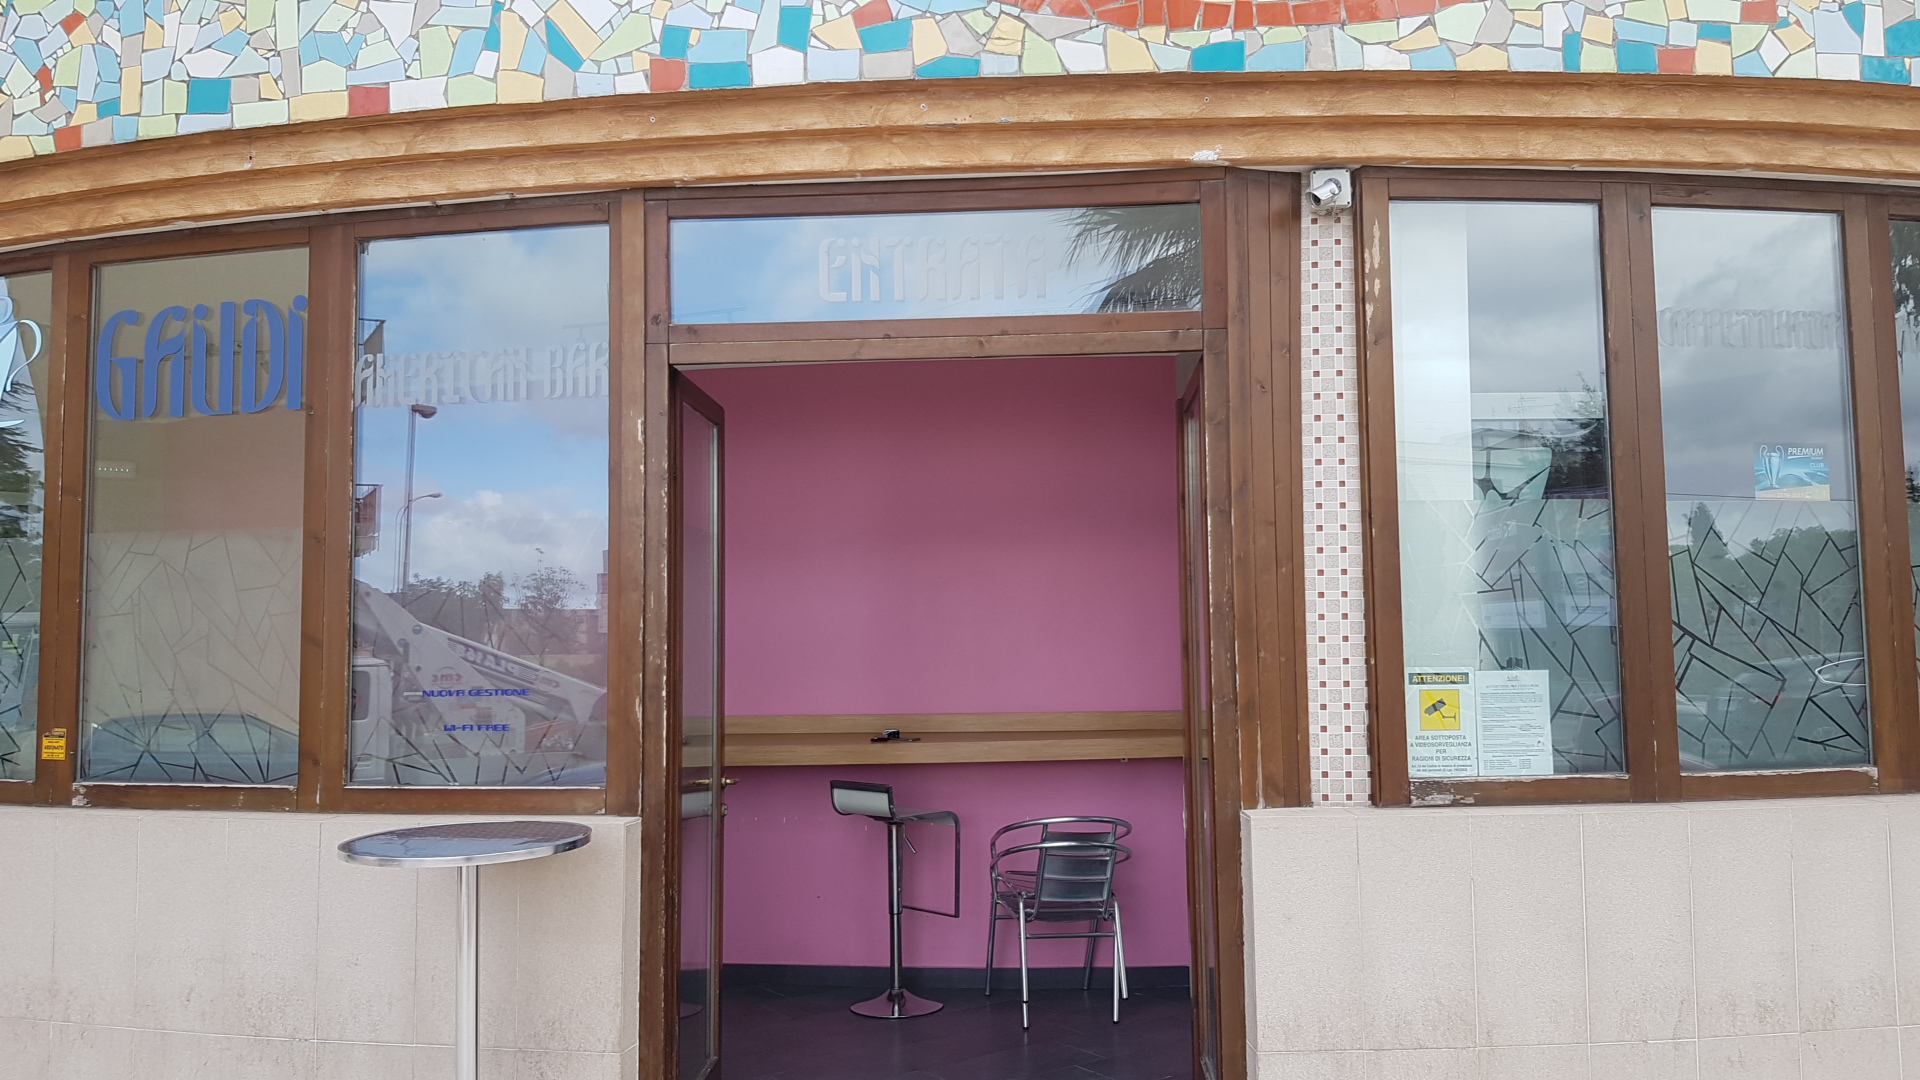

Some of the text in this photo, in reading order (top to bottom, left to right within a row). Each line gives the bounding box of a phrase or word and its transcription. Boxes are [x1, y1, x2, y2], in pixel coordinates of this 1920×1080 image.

[818, 233, 1047, 302] ENTRATA
[96, 294, 308, 420] GAUDI
[355, 341, 609, 408] AMERICAN BAR
[1787, 447, 1824, 456] PREMIUM
[1411, 674, 1466, 683] ATTENZIONE!
[422, 688, 531, 698] NUOVA GESTIONE
[443, 723, 510, 732] WI-FI FREE
